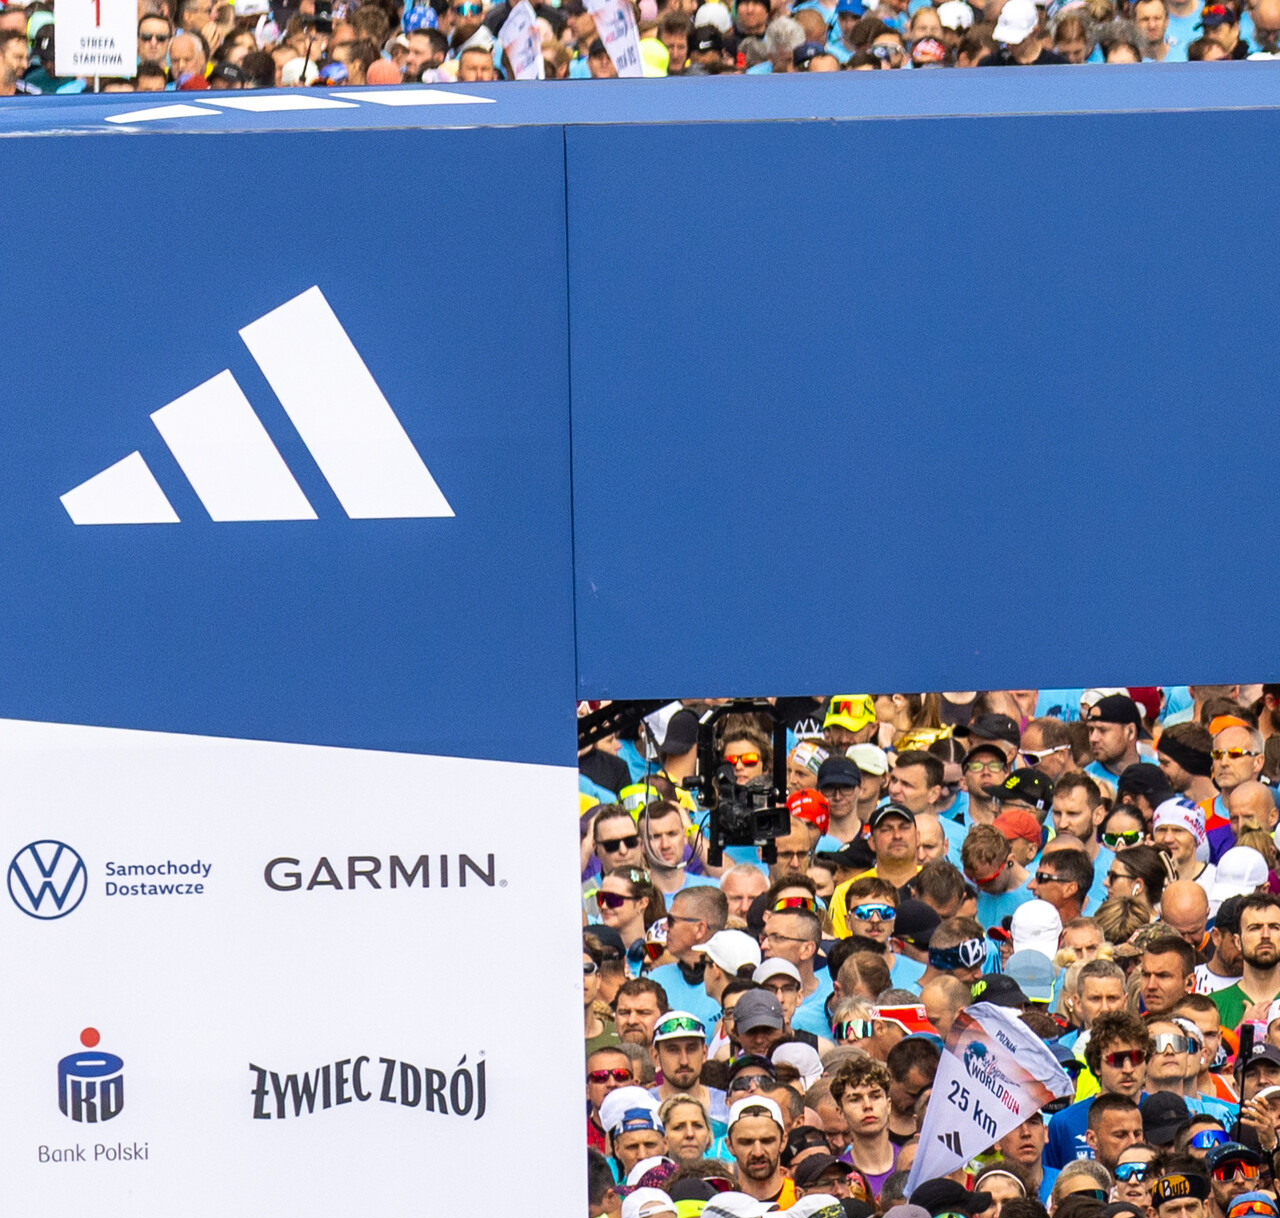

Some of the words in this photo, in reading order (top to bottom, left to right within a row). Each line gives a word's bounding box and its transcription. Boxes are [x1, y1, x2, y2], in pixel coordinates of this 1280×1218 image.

[80, 37, 115, 49] STREFA
[73, 53, 123, 65] STARTOWA
[105, 860, 213, 880] Samochody
[263, 852, 497, 891] GARMIN
[105, 880, 206, 897] Dostawcze
[248, 1055, 372, 1120] ŻYWIEC
[379, 1052, 487, 1121] ZDRÓJ
[970, 1063, 1003, 1099] WORLD
[1000, 1091, 1020, 1116] RUN
[946, 1079, 970, 1113] 25
[971, 1104, 998, 1138] km
[38, 1143, 87, 1163] Bank
[94, 1142, 149, 1161] Polski
